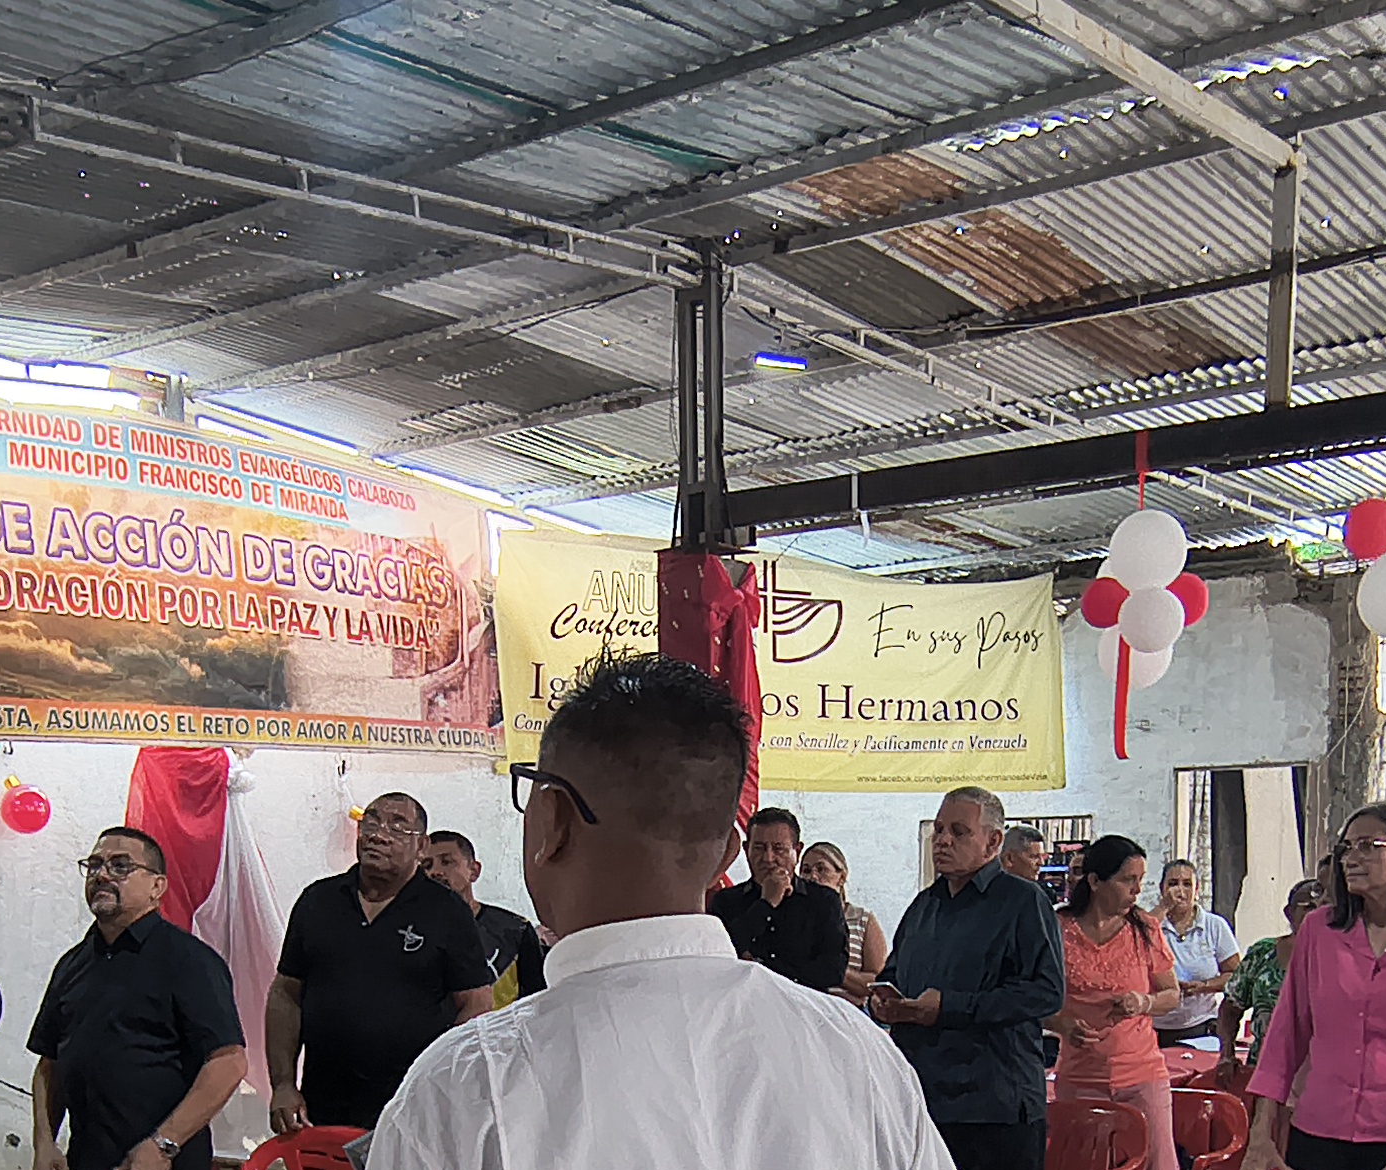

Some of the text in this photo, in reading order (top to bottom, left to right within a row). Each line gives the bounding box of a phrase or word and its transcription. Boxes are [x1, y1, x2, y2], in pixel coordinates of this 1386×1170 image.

[8, 442, 349, 522] MUNICIPIO FRANCISCO DE MIRANDA
[94, 424, 121, 450] DE
[130, 429, 233, 470] MINISTROS
[239, 451, 343, 494] EVANGÉLICOS
[347, 476, 416, 512] CALABOZO
[45, 508, 233, 579] ACCIÓN
[243, 534, 297, 586] DE
[303, 544, 449, 609] GRACIAS
[159, 585, 221, 629] POR
[230, 592, 262, 632] LA
[268, 600, 324, 638] PAZ
[324, 606, 339, 640] Y
[345, 609, 375, 645] LA
[582, 570, 658, 616] ANU
[551, 603, 659, 648] Confere
[868, 603, 1044, 669] En sus Pasos
[46, 710, 170, 732] ASUMAMOS
[176, 714, 197, 733] EL
[203, 716, 249, 736] RETO
[256, 719, 291, 738] POR
[297, 721, 347, 741] AMOR
[351, 724, 362, 742] A
[367, 724, 433, 746] NUESTRA
[761, 684, 1020, 721] os Hermanos
[770, 736, 792, 748] con
[796, 732, 849, 749] Sencillez
[853, 738, 861, 754] y
[864, 733, 949, 751] Pacíficamente
[951, 738, 964, 750] en
[969, 733, 1028, 750] Venezuela
